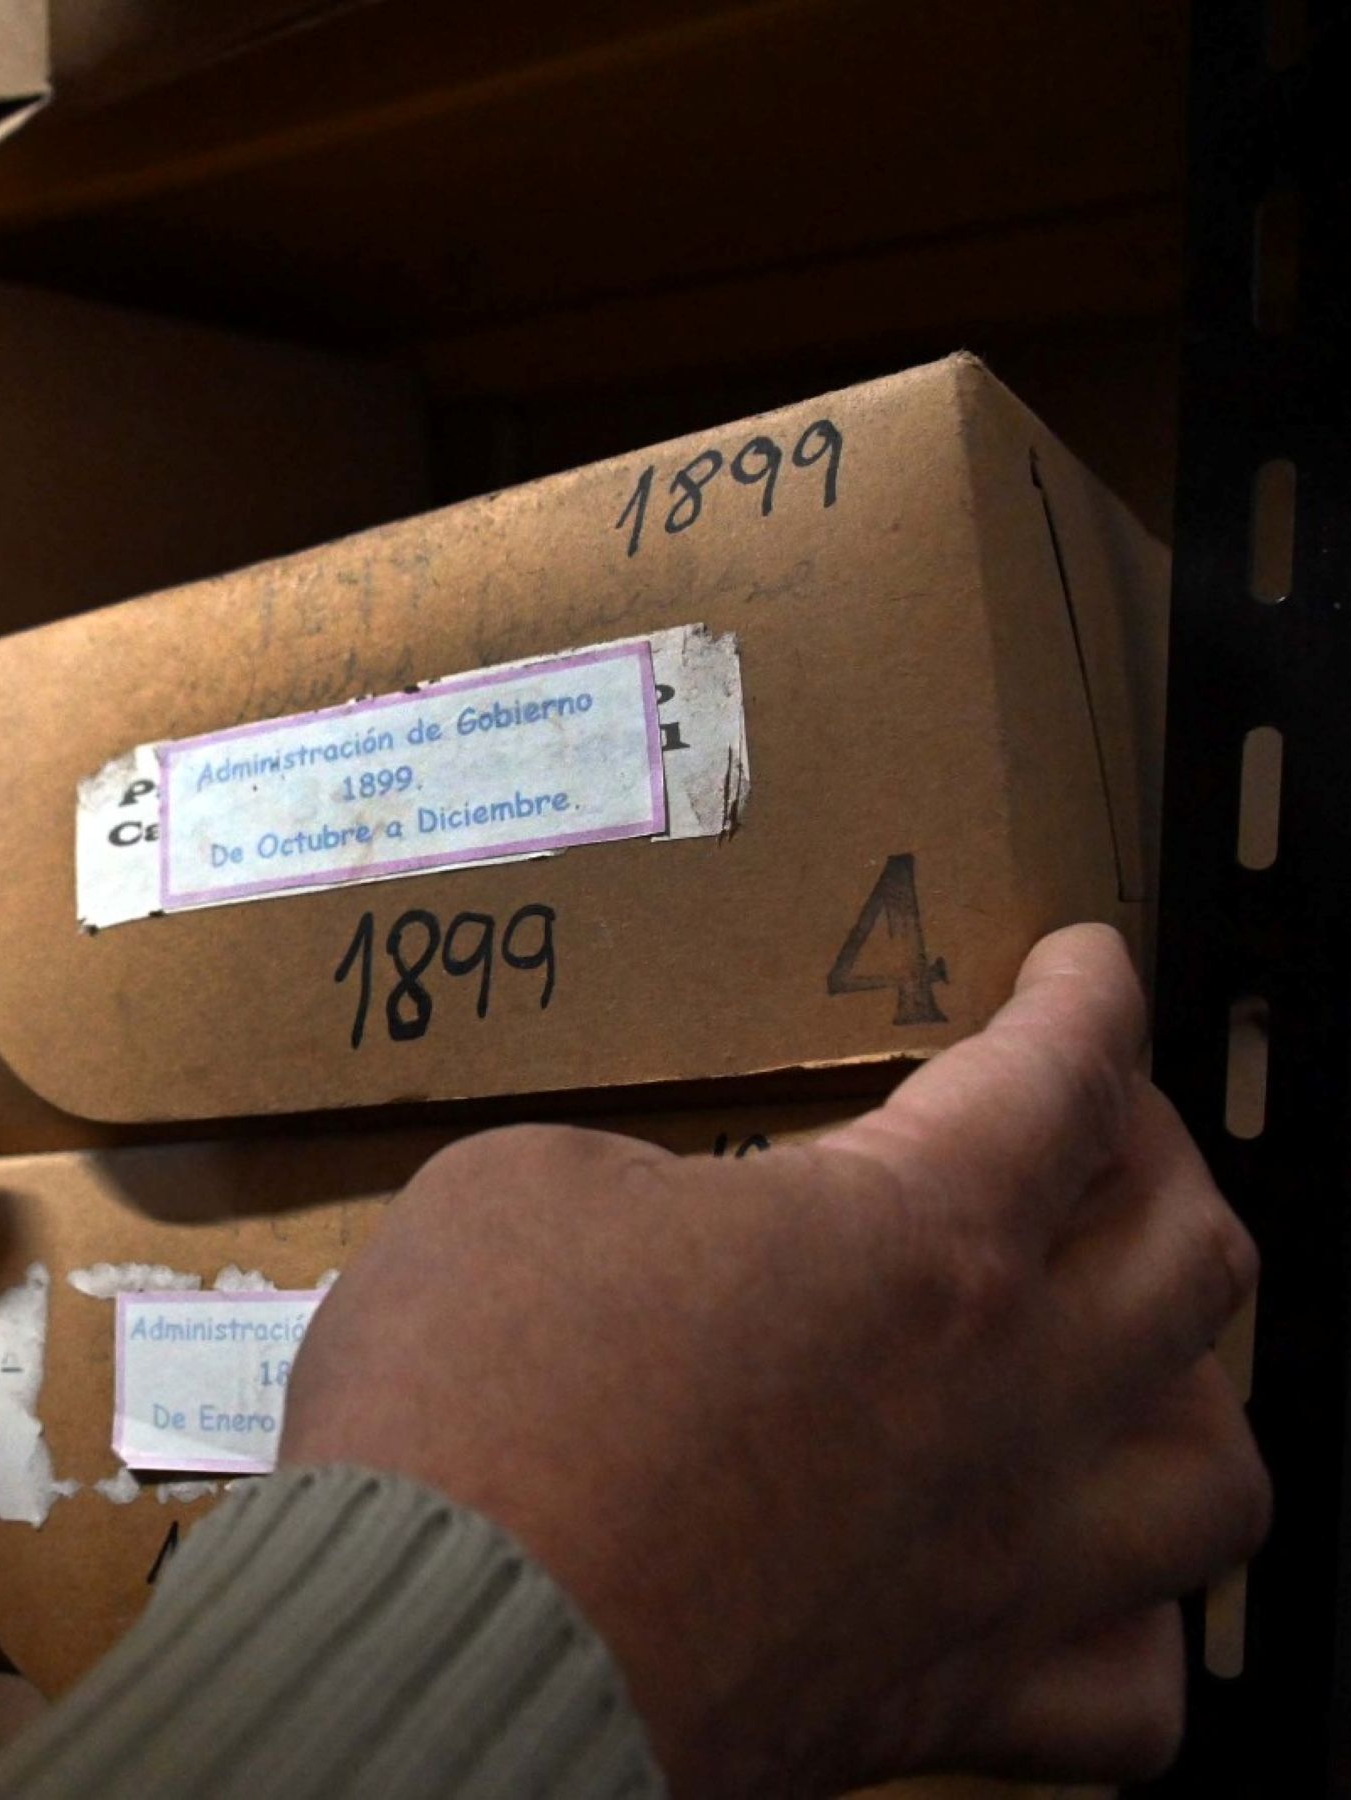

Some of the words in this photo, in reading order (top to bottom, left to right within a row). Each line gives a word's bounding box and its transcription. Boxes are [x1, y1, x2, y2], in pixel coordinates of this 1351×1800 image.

[615, 418, 844, 557] 1899
[196, 727, 394, 793] Administración
[407, 718, 442, 746] de
[456, 690, 593, 737] Gobierno
[342, 764, 423, 802] 1899.
[210, 843, 244, 870] De
[257, 823, 372, 860] Octubre
[385, 819, 403, 839] a
[417, 790, 581, 835] Diciembre.
[334, 903, 556, 1050] 1899
[826, 853, 951, 1027] 4
[130, 1314, 306, 1342] Administració
[259, 1360, 291, 1387] 18
[153, 1402, 187, 1431] De
[199, 1404, 276, 1433] Enero
